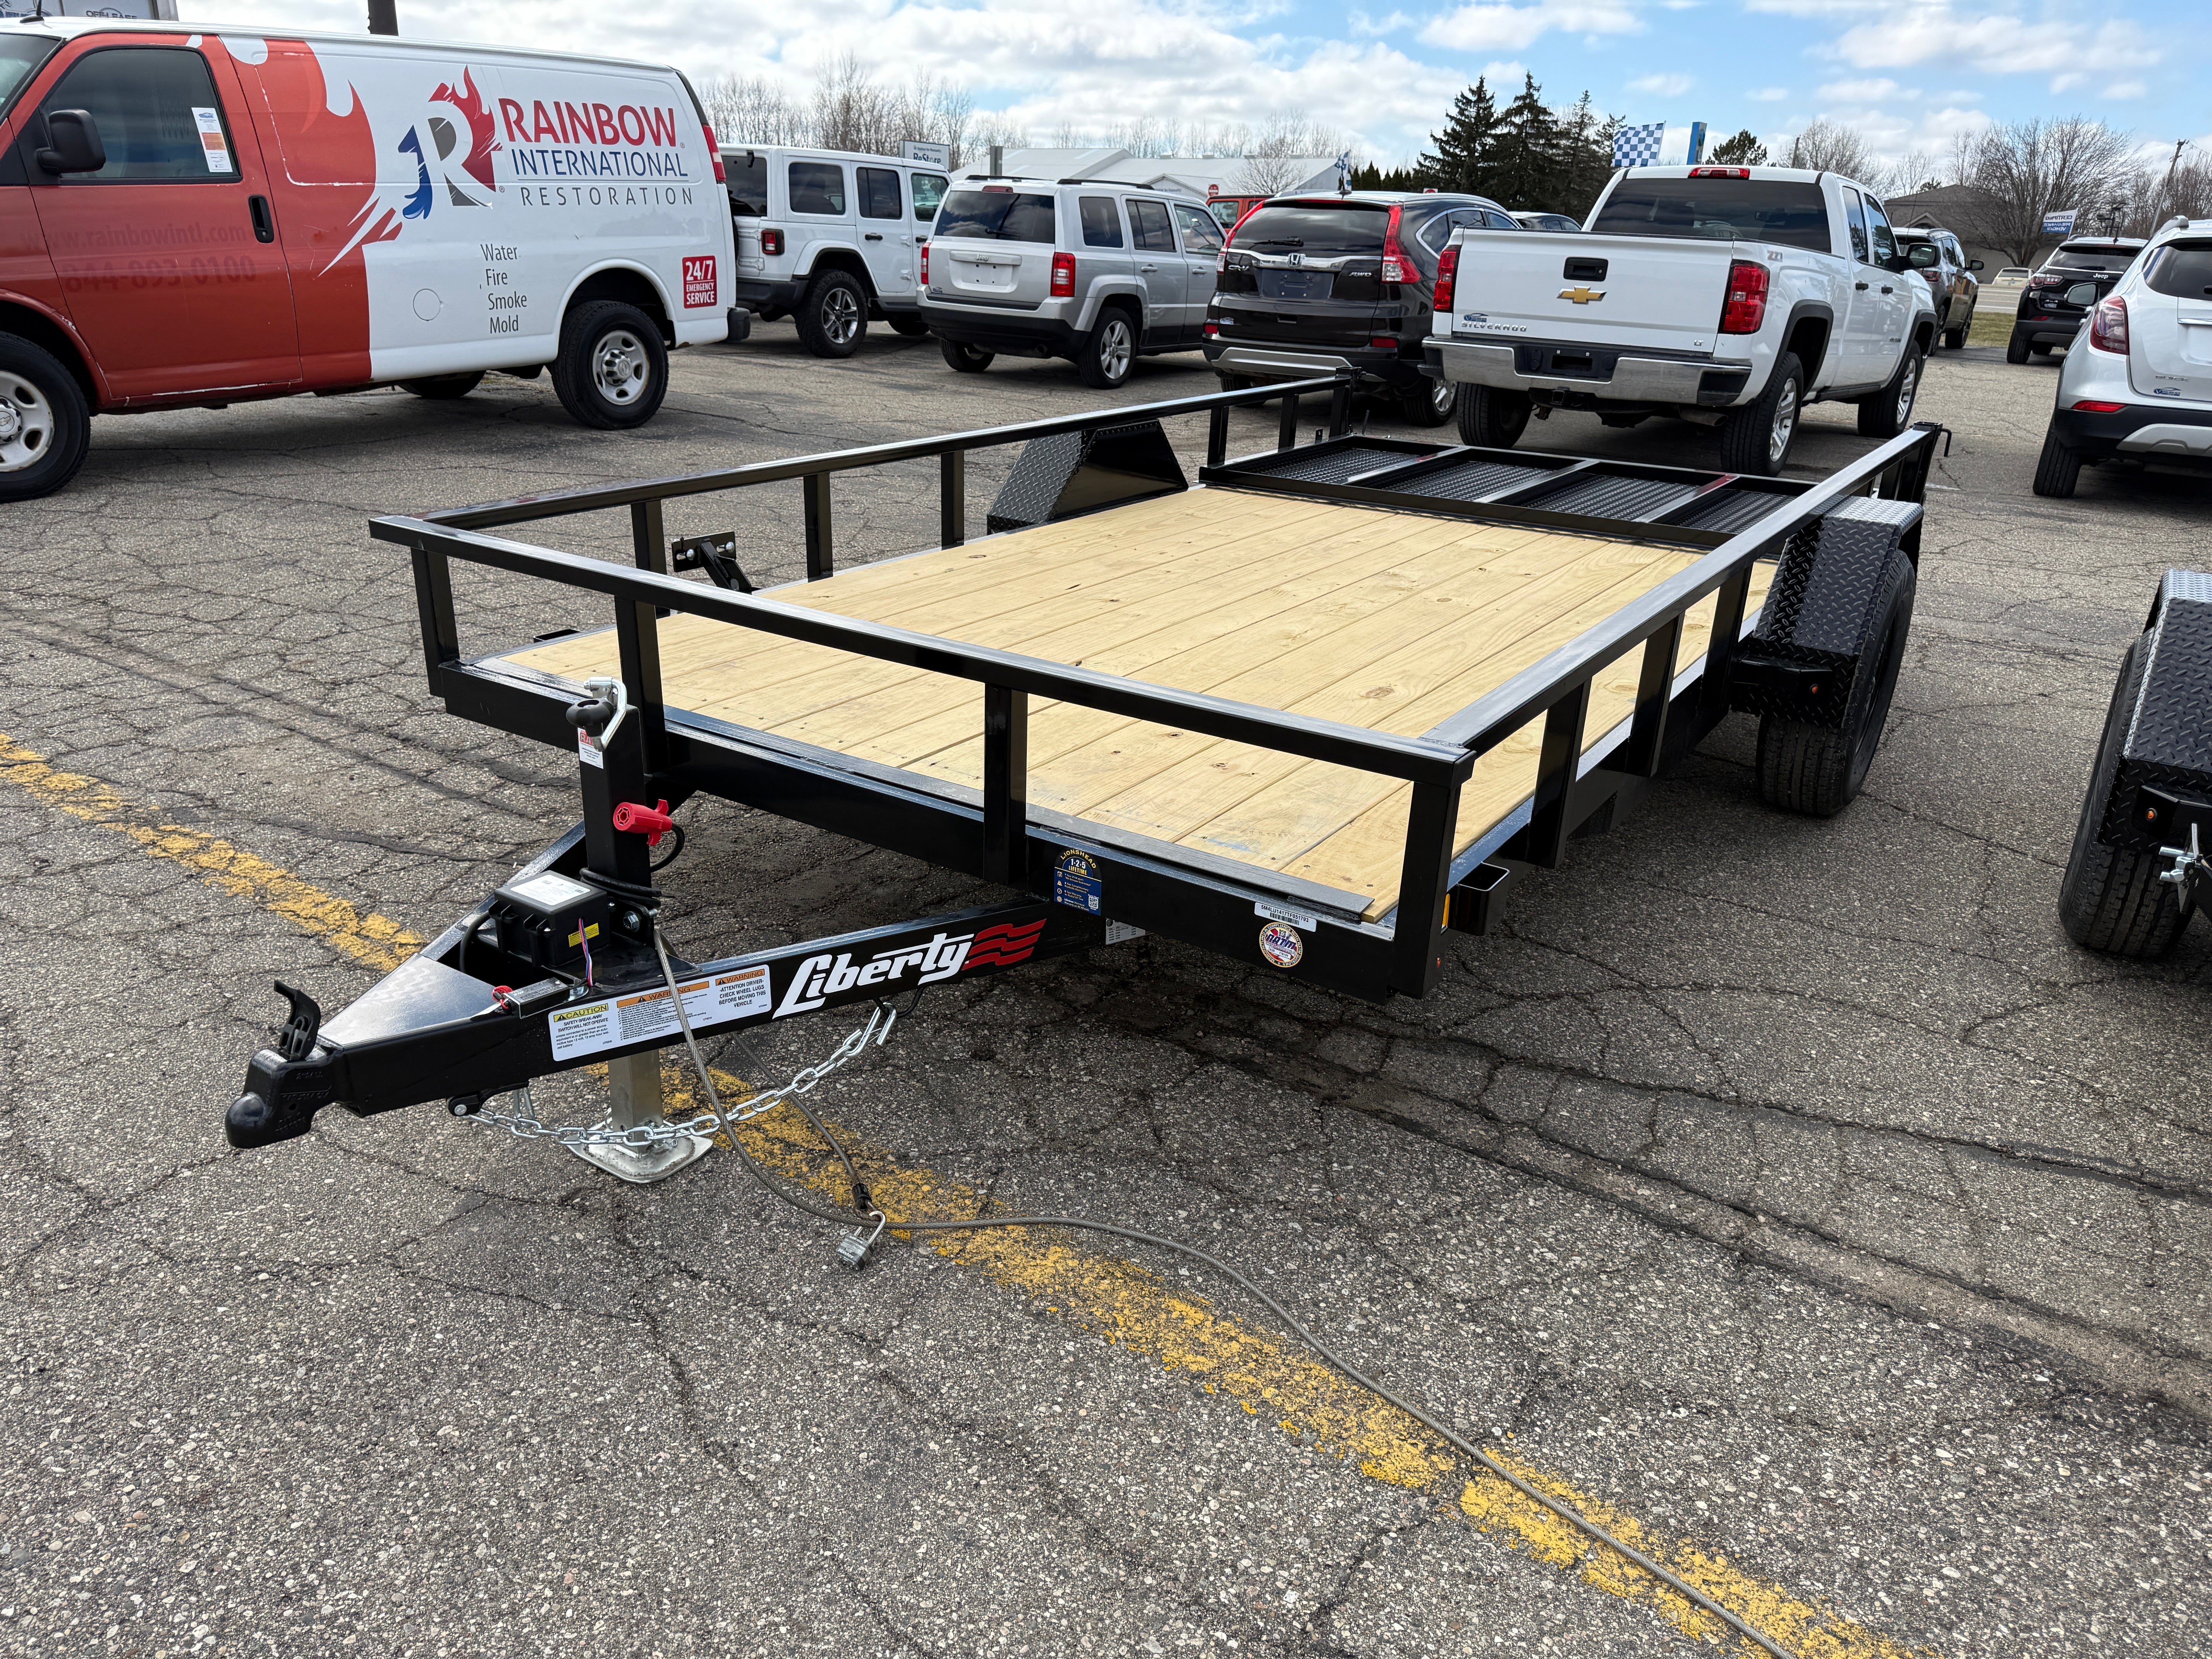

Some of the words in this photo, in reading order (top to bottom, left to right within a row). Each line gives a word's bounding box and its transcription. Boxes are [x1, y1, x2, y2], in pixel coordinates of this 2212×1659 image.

[498, 98, 676, 147] RAINBOW
[511, 149, 688, 177] INTERNATIONAL
[914, 153, 941, 164] ReStore
[520, 187, 692, 206] RESTORATION
[480, 243, 517, 261] Water
[486, 268, 508, 286] Fire
[685, 260, 713, 281] 24/7
[686, 282, 714, 292] EMERGENCY
[488, 291, 527, 310] Smoke
[687, 291, 714, 305] SERVICE
[490, 314, 519, 334] Mold
[1461, 321, 1527, 332] SILVERADO
[1060, 849, 1096, 868] LIONSHEAD
[1068, 866, 1087, 875] LIFETIME
[1261, 905, 1309, 922] 5M4LU1417TF051793
[726, 970, 763, 982] WARNING
[772, 933, 974, 1019] Liberty
[649, 987, 690, 1000] WARNG
[719, 996, 737, 1005] BEFORE
[566, 1005, 607, 1018] CAUTION
[579, 1014, 603, 1023] BREAK-AWAY
